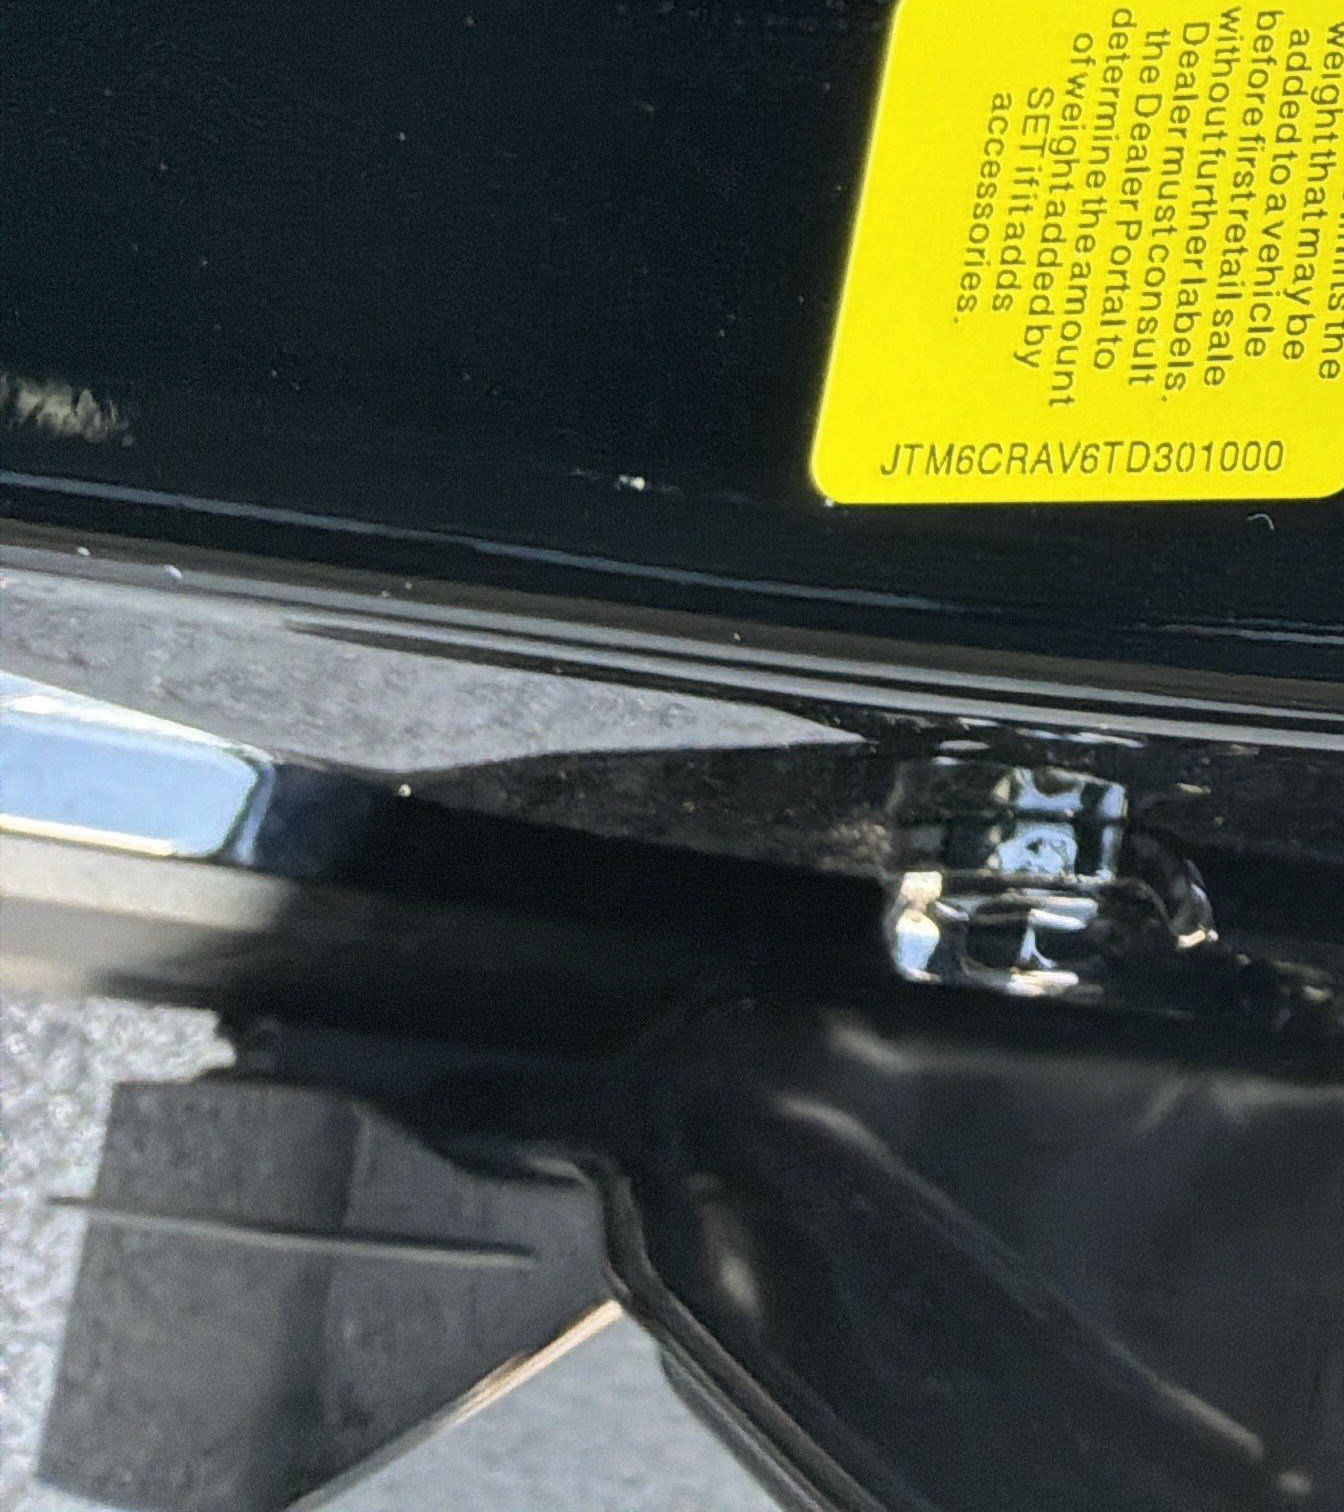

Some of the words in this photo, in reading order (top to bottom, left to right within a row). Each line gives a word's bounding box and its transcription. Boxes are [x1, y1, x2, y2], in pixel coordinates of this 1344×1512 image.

[1069, 32, 1097, 66] of
[1137, 27, 1171, 84] the
[1166, 21, 1210, 139] Dealer
[1201, 5, 1241, 142] without
[1241, 9, 1284, 126] before
[1274, 28, 1312, 144] added
[1018, 86, 1055, 159] SET
[1047, 71, 1088, 194] weight
[1084, 7, 1138, 188] determine
[1118, 92, 1163, 212] Dealer
[1150, 145, 1184, 237] must
[1229, 132, 1266, 202] first
[1268, 149, 1298, 185] to
[1301, 148, 1337, 221] that
[952, 92, 1012, 324] accessories.
[1073, 195, 1108, 253] the
[1182, 146, 1227, 271] further
[1263, 192, 1287, 215] a
[991, 221, 1027, 312] adds
[1027, 200, 1066, 316] added
[1099, 219, 1143, 326] Portal
[1215, 208, 1249, 300] retail
[1243, 219, 1284, 357] vehicle
[1281, 227, 1320, 305] may
[1012, 324, 1053, 368] by
[1047, 260, 1092, 407] amount
[1092, 333, 1123, 370] to
[1127, 243, 1169, 386] consult
[1161, 276, 1207, 401] labels.
[1202, 308, 1234, 386] sale
[1281, 313, 1315, 360] be
[879, 439, 1284, 475] JTM6CRAV6TD301000
